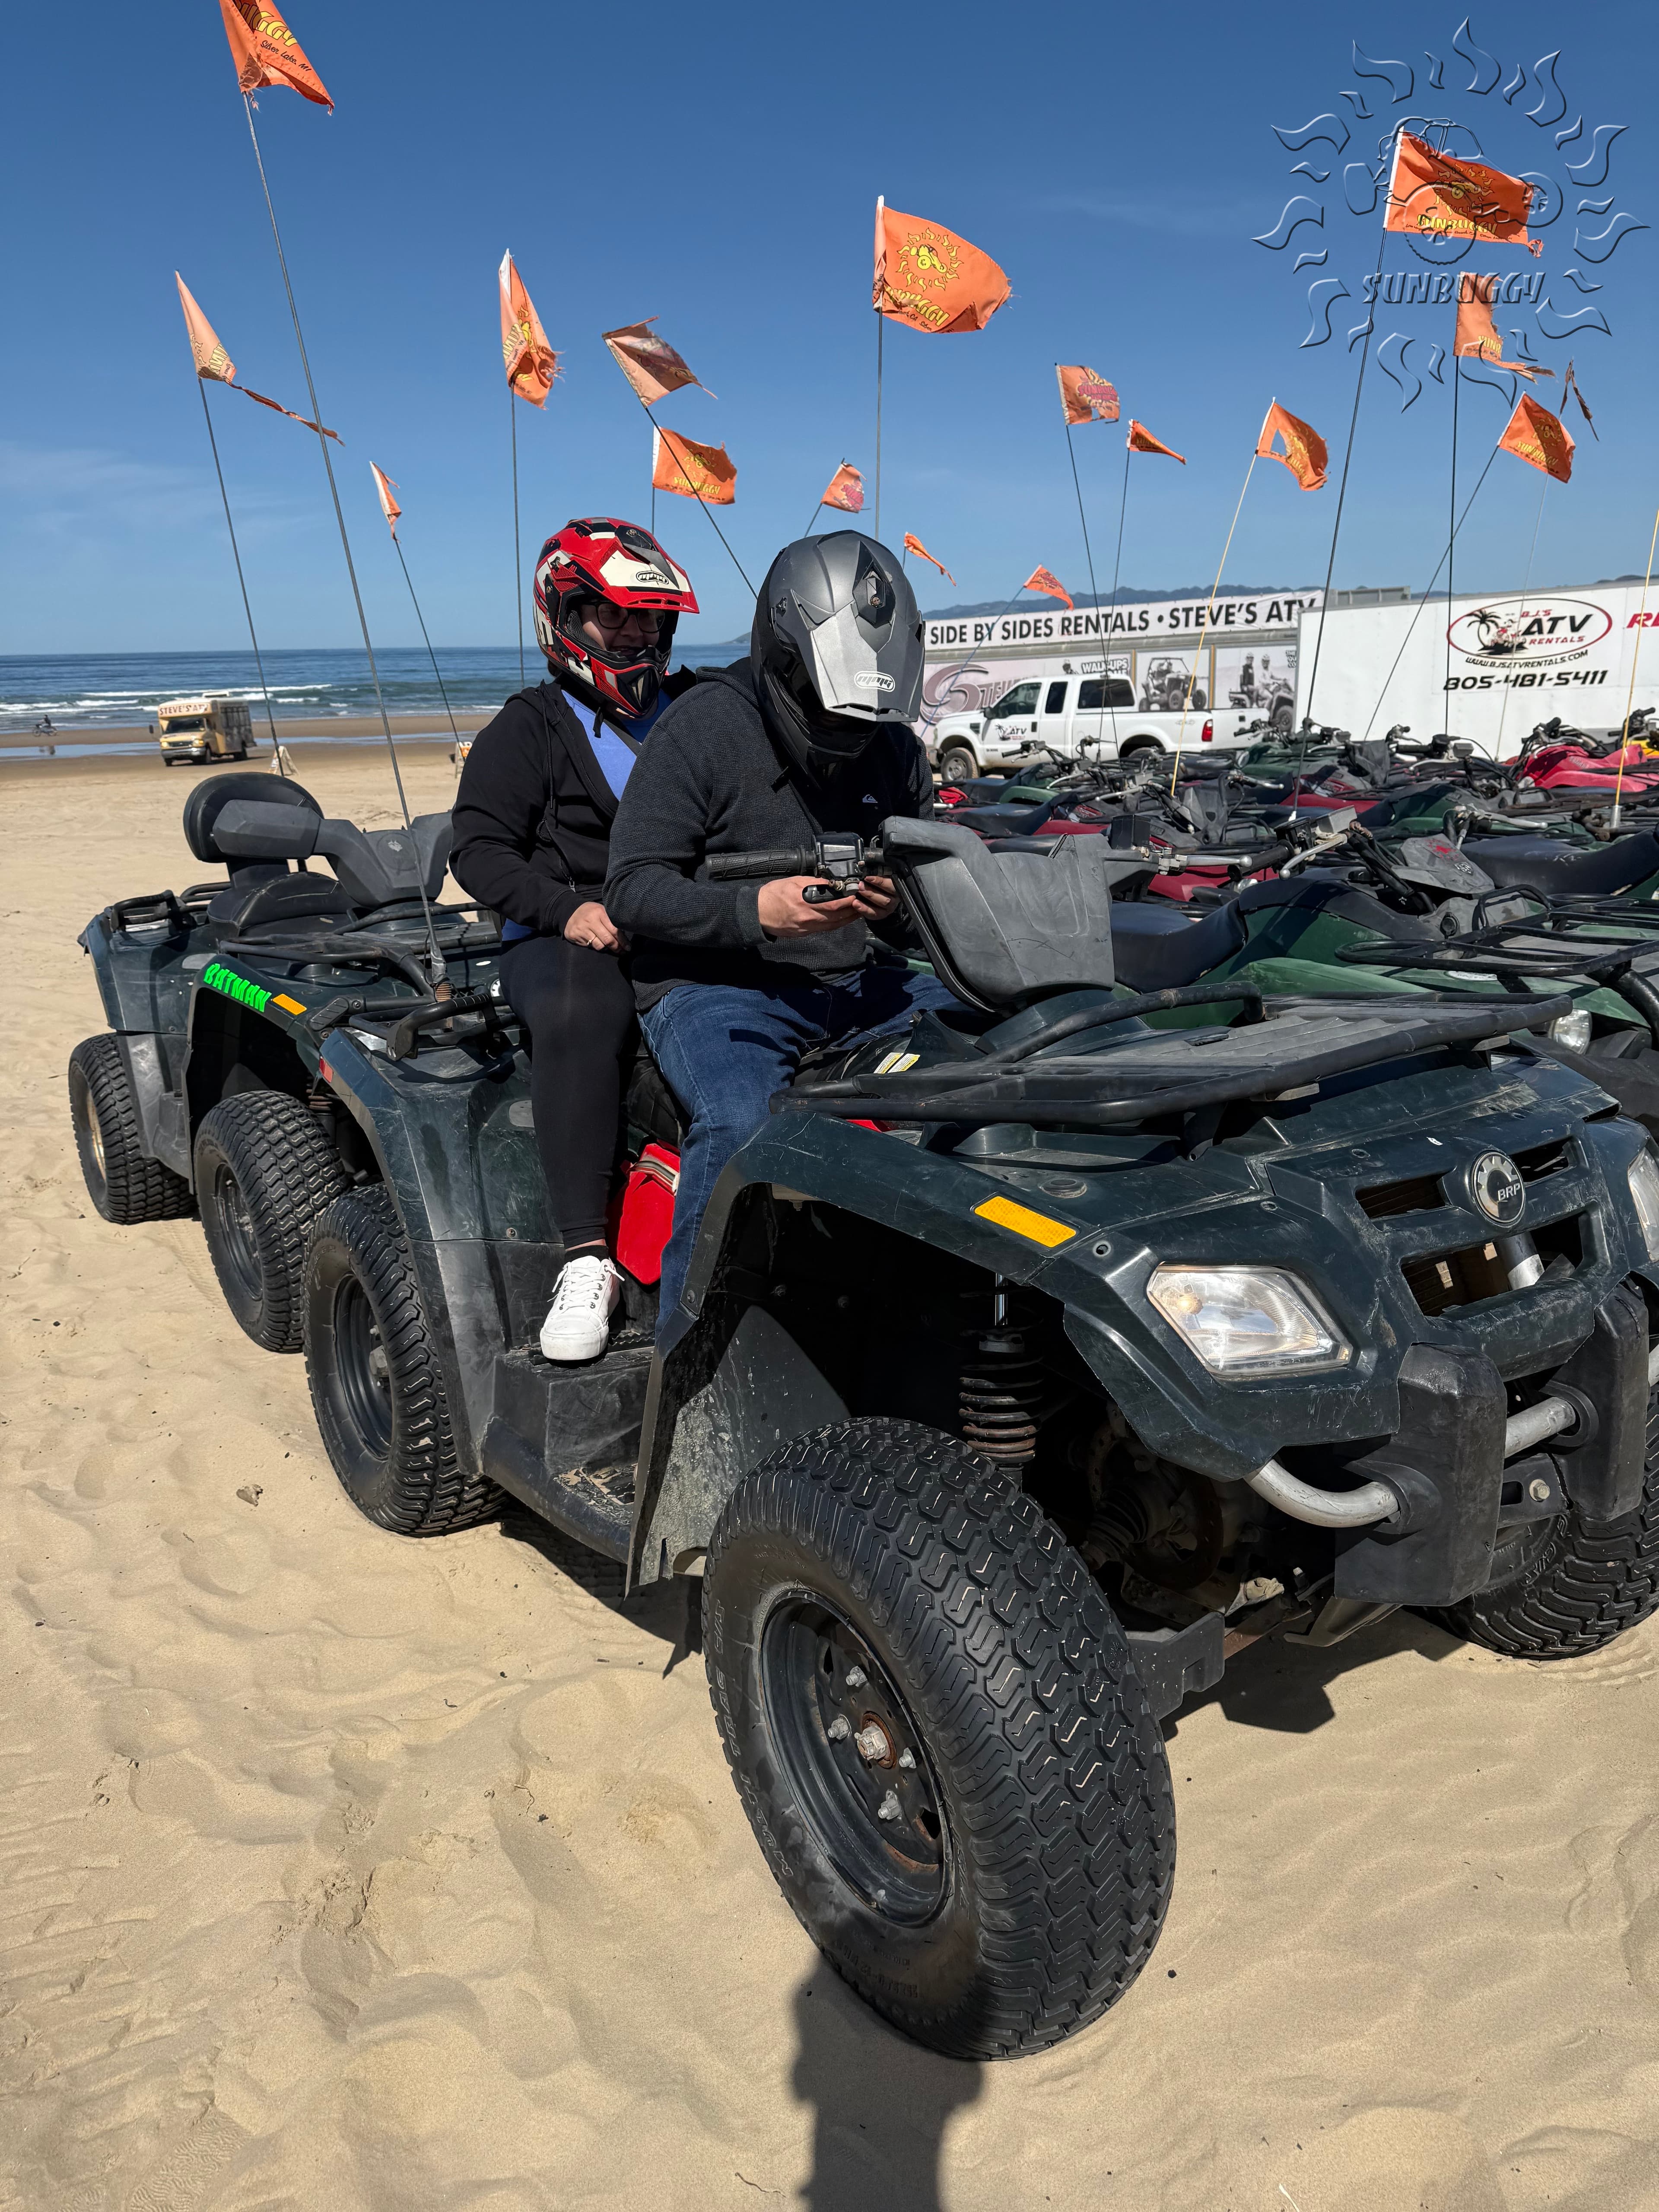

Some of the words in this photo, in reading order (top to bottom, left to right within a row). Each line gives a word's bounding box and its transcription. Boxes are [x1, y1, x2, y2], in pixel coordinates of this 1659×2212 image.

[931, 624, 967, 645] SIDE
[974, 623, 995, 642] BY
[1001, 617, 1053, 640] SIDES
[1061, 610, 1149, 636] RENTALS
[1169, 602, 1258, 629] STEVE'S
[1522, 614, 1593, 636] ATV
[1529, 636, 1586, 645] RENTALS
[1443, 670, 1608, 690] 805-481-5411
[159, 705, 191, 715] STEVE'S
[203, 963, 272, 1013] BATMAN
[1497, 1183, 1521, 1201] BRP
